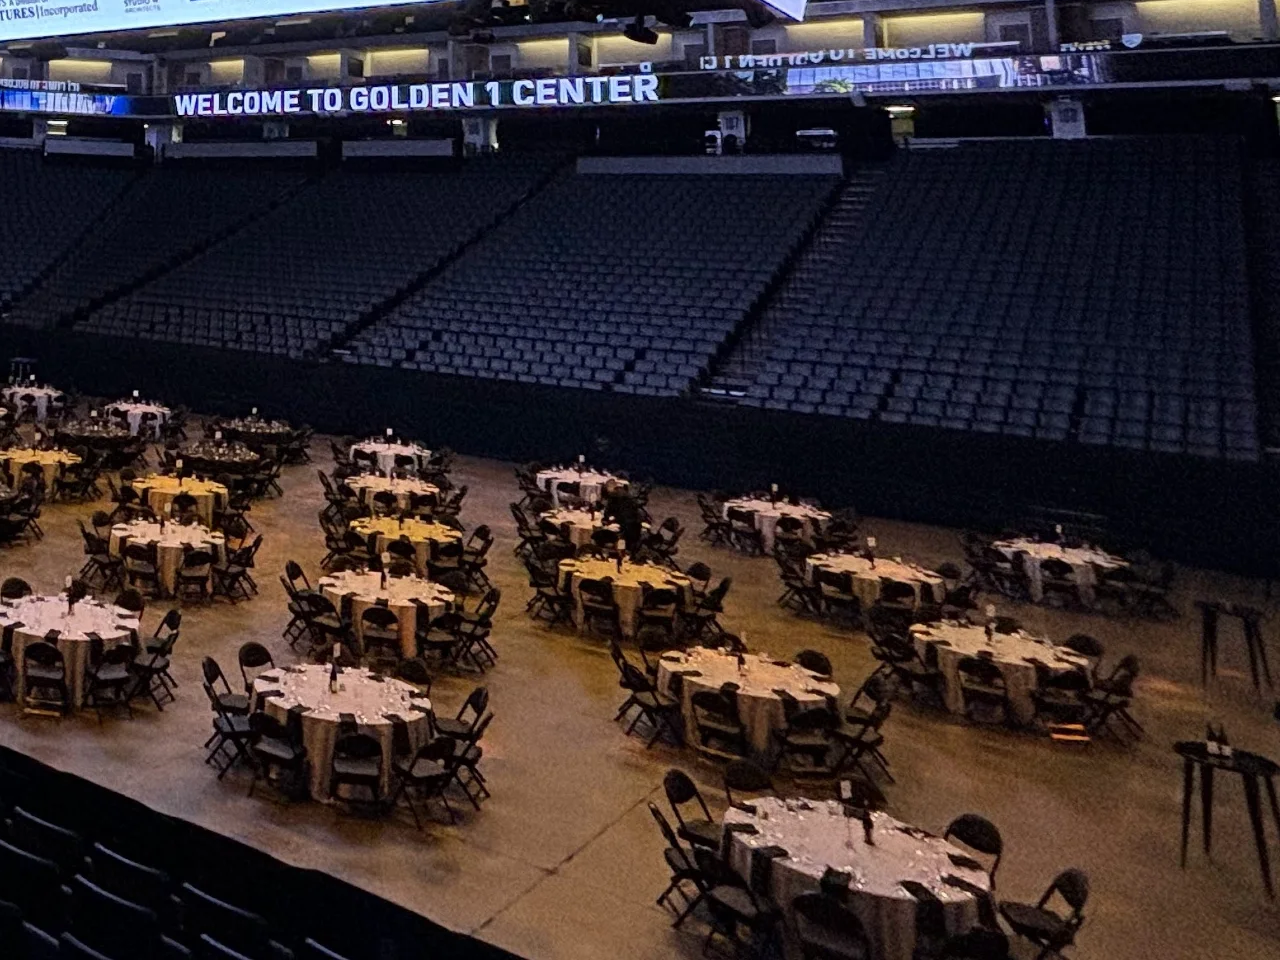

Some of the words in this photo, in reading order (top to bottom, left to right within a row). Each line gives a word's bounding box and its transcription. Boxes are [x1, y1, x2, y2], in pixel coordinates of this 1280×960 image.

[40, 0, 99, 18] Incorporated
[174, 89, 301, 116] WELCOME
[306, 87, 343, 112] TO
[350, 81, 474, 111] GOLDEN
[486, 81, 499, 106] 1
[512, 75, 659, 105] CENTER
